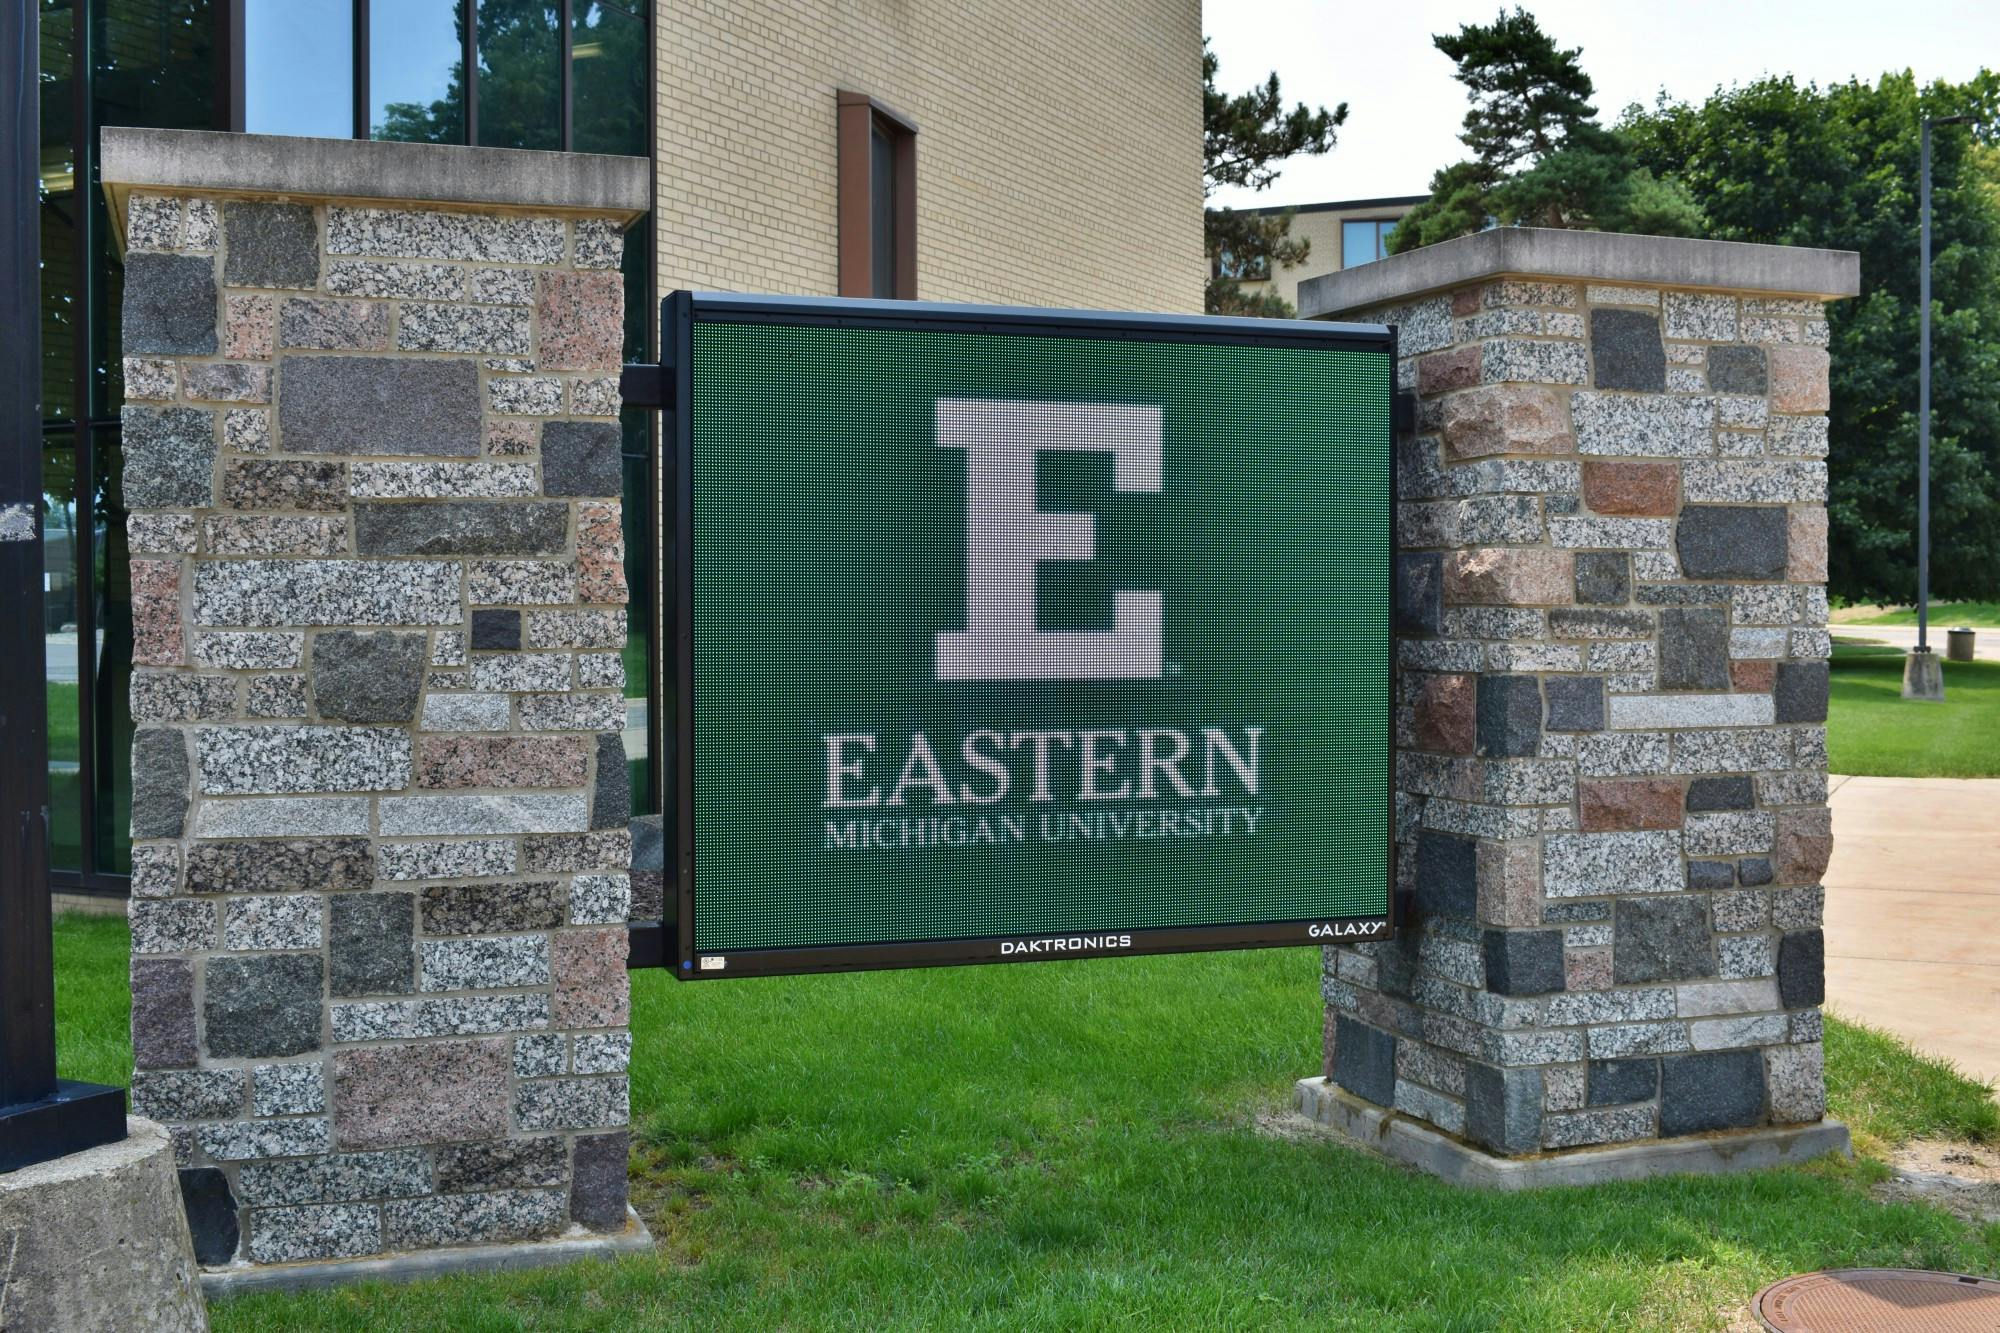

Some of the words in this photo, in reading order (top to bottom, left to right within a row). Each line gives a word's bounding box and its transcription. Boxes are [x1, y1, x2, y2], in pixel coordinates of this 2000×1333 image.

[936, 397, 1164, 680] E
[823, 726, 1264, 807] EASTERN
[824, 815, 1025, 849] MICHIGAN
[1041, 807, 1263, 843] UNIVERSITY
[1000, 935, 1131, 954] DAKTRONICS
